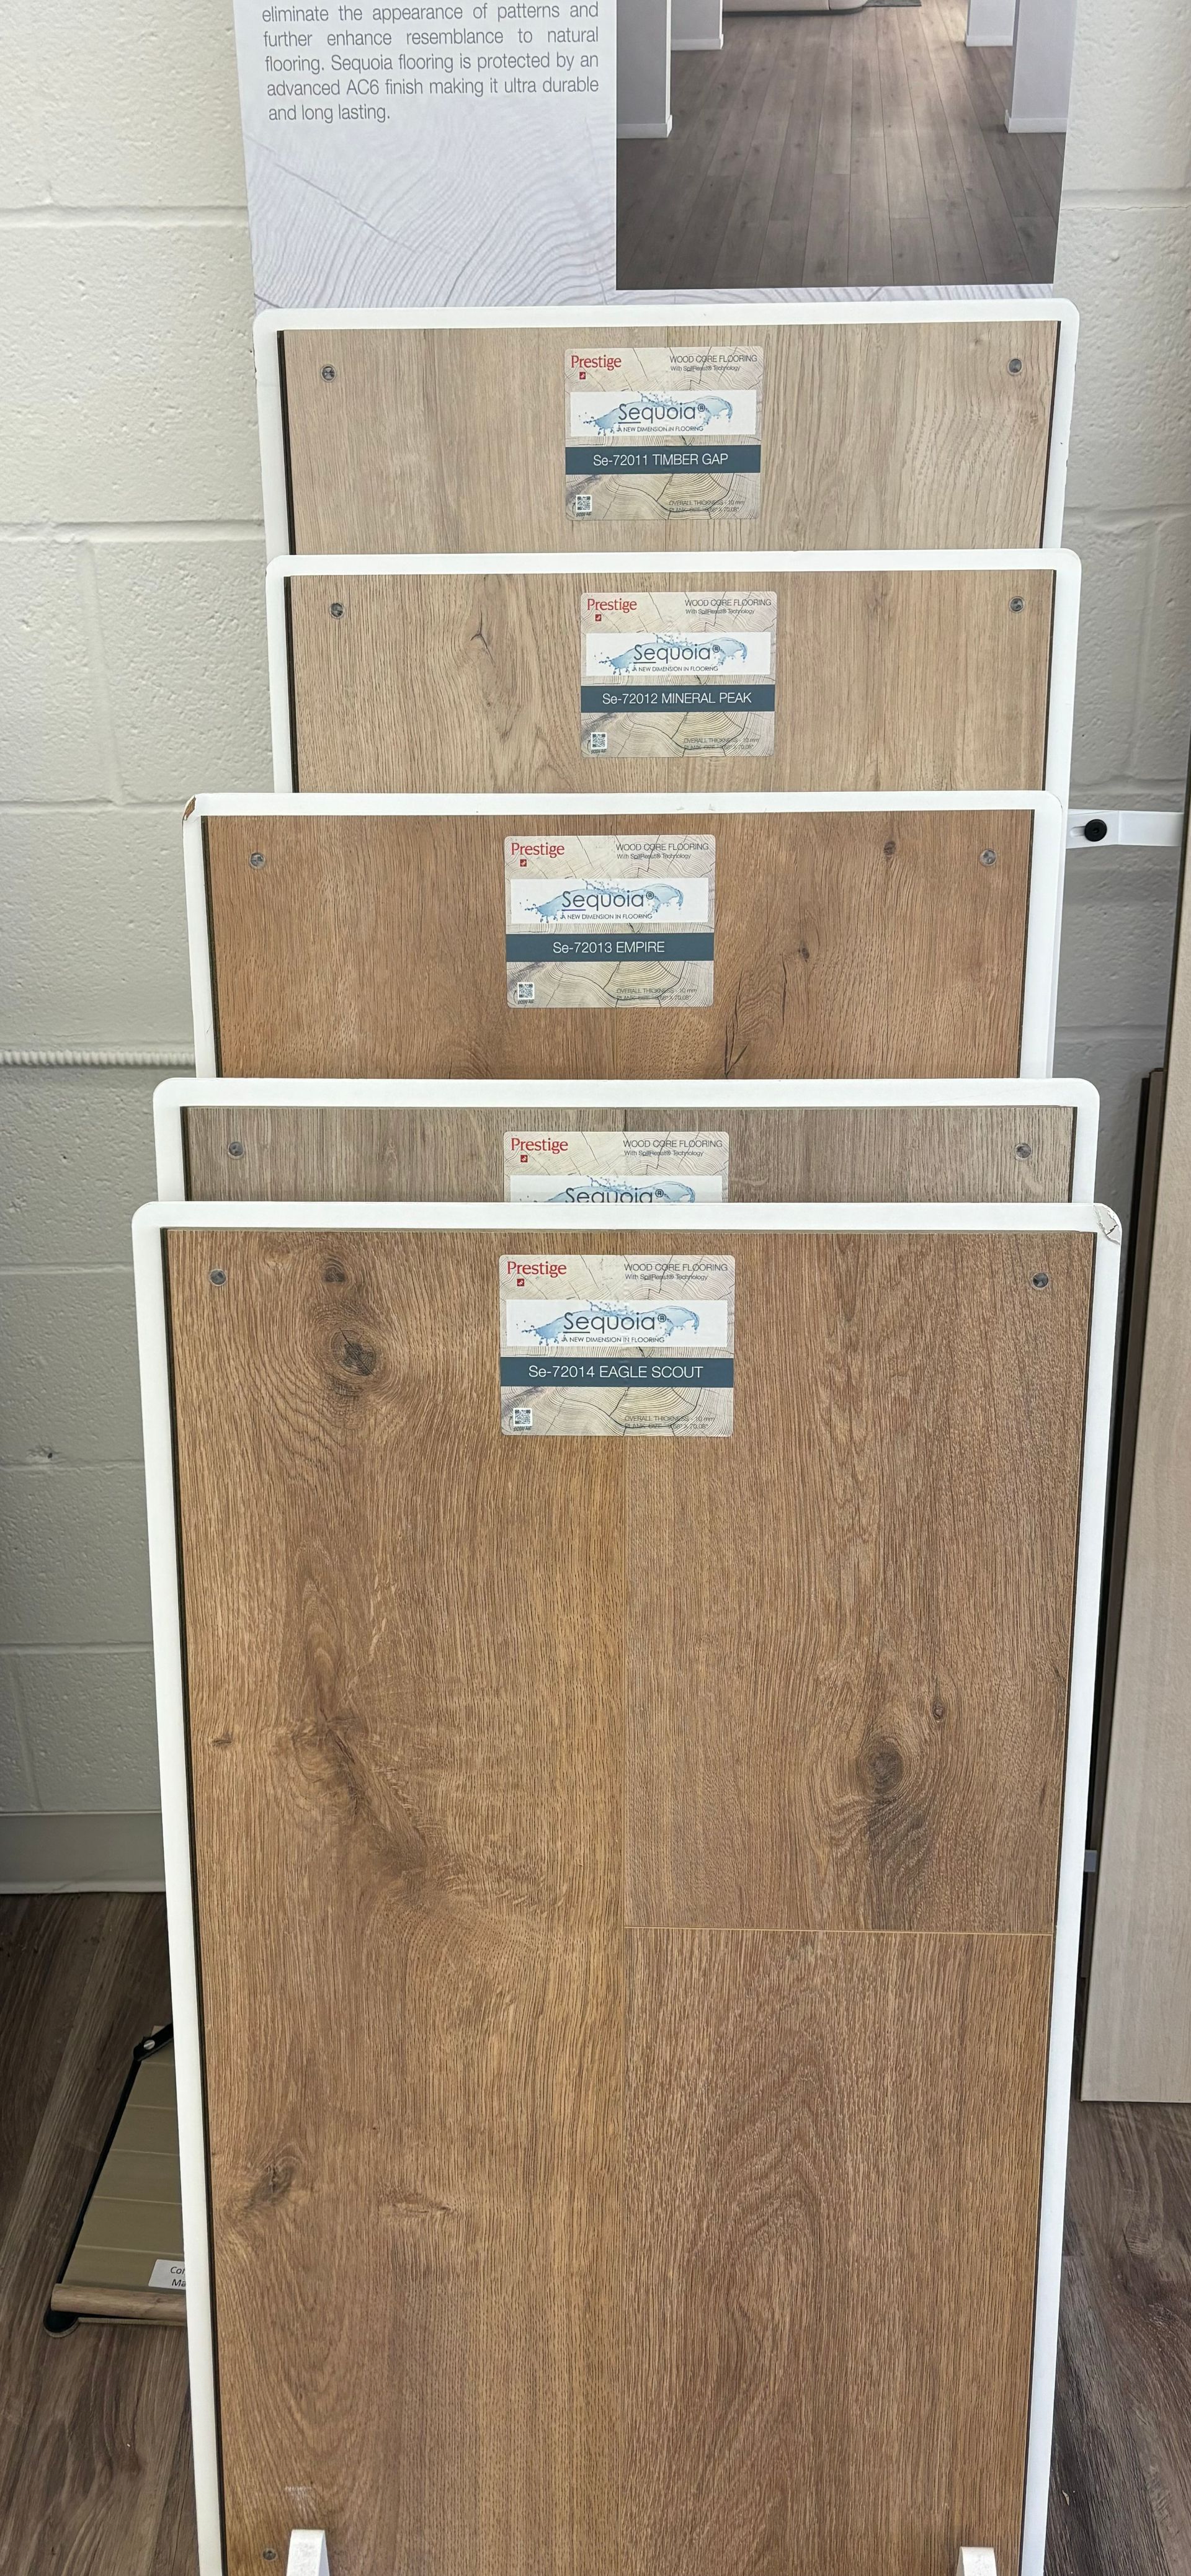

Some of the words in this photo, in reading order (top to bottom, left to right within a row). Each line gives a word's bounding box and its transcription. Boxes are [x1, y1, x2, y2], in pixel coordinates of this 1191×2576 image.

[262, 6, 329, 22] eliminate
[338, 6, 362, 20] the
[372, 5, 463, 24] appearance
[473, 3, 488, 19] of
[497, 3, 560, 22] patterns
[570, 1, 599, 17] and
[264, 31, 312, 47] further
[328, 30, 392, 46] enhance
[406, 29, 504, 45] resemblance
[517, 28, 532, 43] to
[547, 26, 599, 43] natural
[265, 56, 324, 74] flooring.
[331, 54, 393, 74] Sequoia
[398, 54, 453, 73] flooring
[460, 53, 471, 69] is
[477, 53, 550, 72] protected
[556, 52, 574, 70] by
[580, 55, 599, 68] an
[267, 79, 341, 96] advanced
[346, 79, 379, 95] AC6
[385, 79, 423, 94] finish
[429, 78, 484, 97] making
[489, 78, 498, 93] it
[504, 77, 537, 94] ultra
[542, 76, 599, 93] durable
[269, 105, 297, 121] and
[301, 105, 334, 123] long
[338, 104, 390, 122] lasting.
[571, 355, 622, 371] Prestige
[593, 455, 648, 466] Se-72011
[653, 454, 698, 465] TIMBER
[702, 453, 728, 465] GAP
[587, 598, 637, 613] Prestige
[602, 693, 658, 704] Se-72012
[662, 693, 716, 704] MINERAL
[720, 692, 752, 703] PEAK
[511, 842, 565, 858] Prestige
[553, 942, 612, 953] Se-72013
[617, 941, 665, 953] EMPIRE
[511, 1138, 568, 1154] Prestige
[507, 1261, 567, 1278] Prestige
[529, 1365, 595, 1378] Se-72014
[600, 1366, 647, 1378] EAGLE
[651, 1366, 703, 1378] SCOUT
